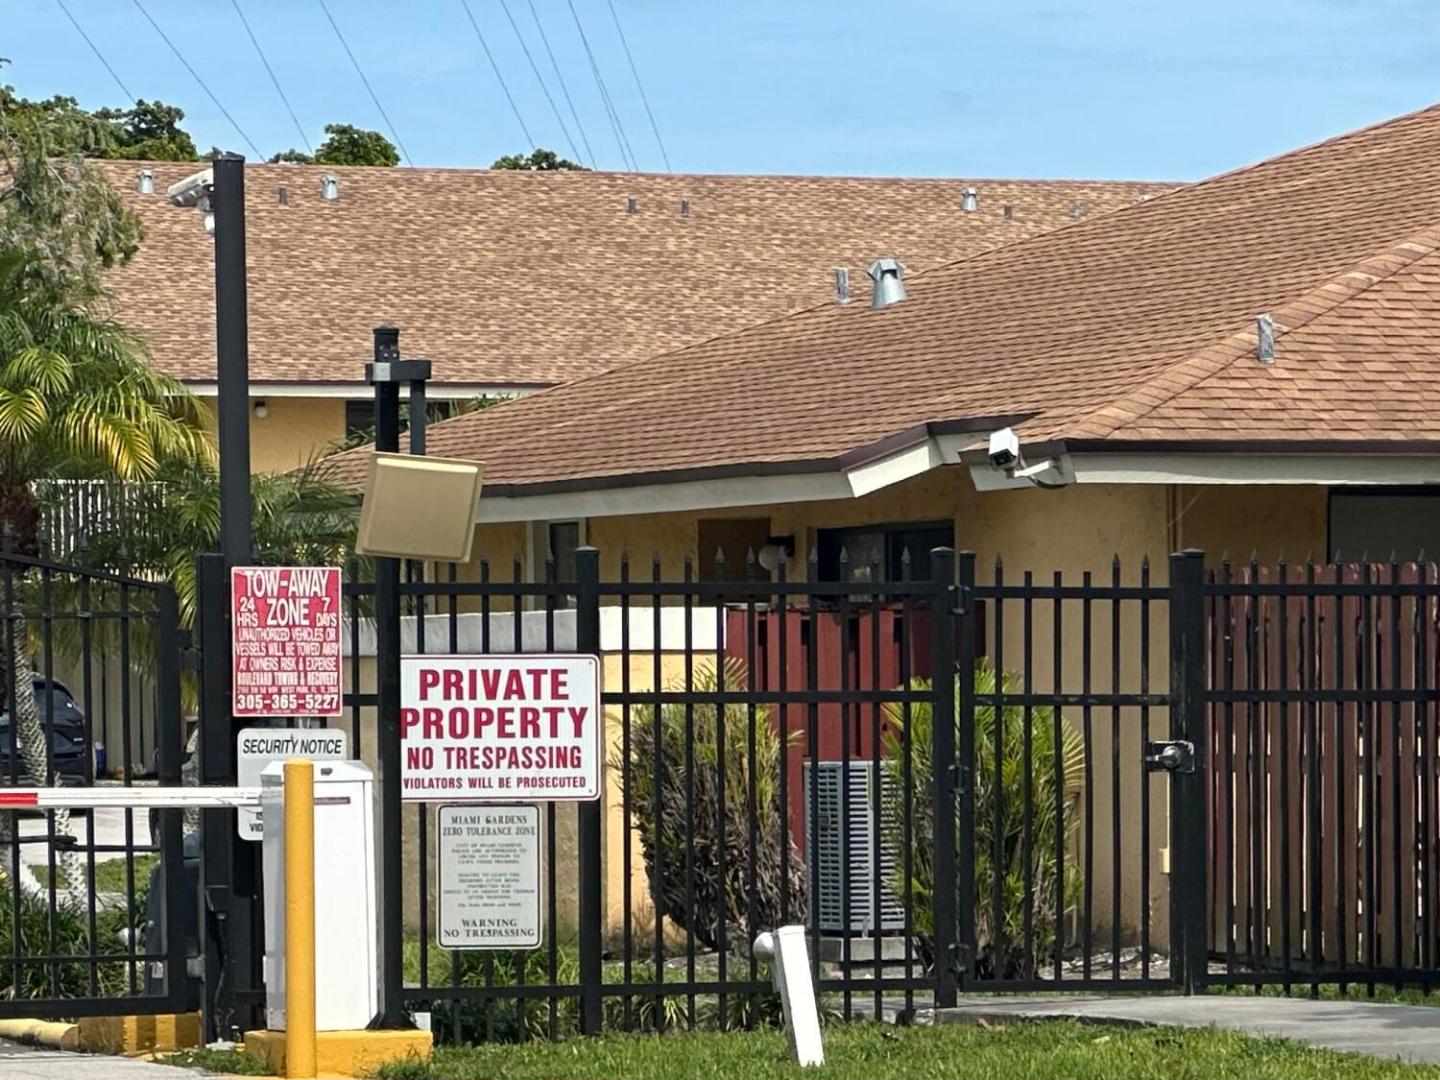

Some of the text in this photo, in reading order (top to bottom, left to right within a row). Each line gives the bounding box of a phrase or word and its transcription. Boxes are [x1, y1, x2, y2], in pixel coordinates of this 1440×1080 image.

[244, 570, 329, 597] TOW-AWAY
[239, 597, 255, 612] 24
[266, 598, 310, 626] ZONE
[321, 597, 331, 612] 7
[237, 612, 259, 627] HRS
[315, 612, 337, 627] DAYS
[238, 627, 336, 641] UNAUTHORIZED VEHICLES OR
[235, 642, 266, 656] VESSELS
[268, 642, 284, 656] WILL
[285, 642, 295, 656] BE
[297, 642, 320, 656] TOWED
[280, 657, 297, 671] RISK
[306, 657, 337, 671] EXPENSE
[419, 669, 569, 701] PRIVATE
[237, 694, 339, 709] 305-365-5227
[400, 706, 589, 740] PROPERTY
[242, 739, 343, 754] SECURITY NOTICE
[407, 746, 582, 770] NO TRESPASSING
[403, 776, 587, 790] VIOLATORS WILL BE PROSECUTED
[249, 823, 264, 832] VID
[451, 815, 528, 825] MIAMI GARDENS
[443, 826, 536, 836] ZERO TOLERANCE ZONE
[461, 918, 517, 928] WARNING
[444, 928, 535, 938] NO TRESPASSING
